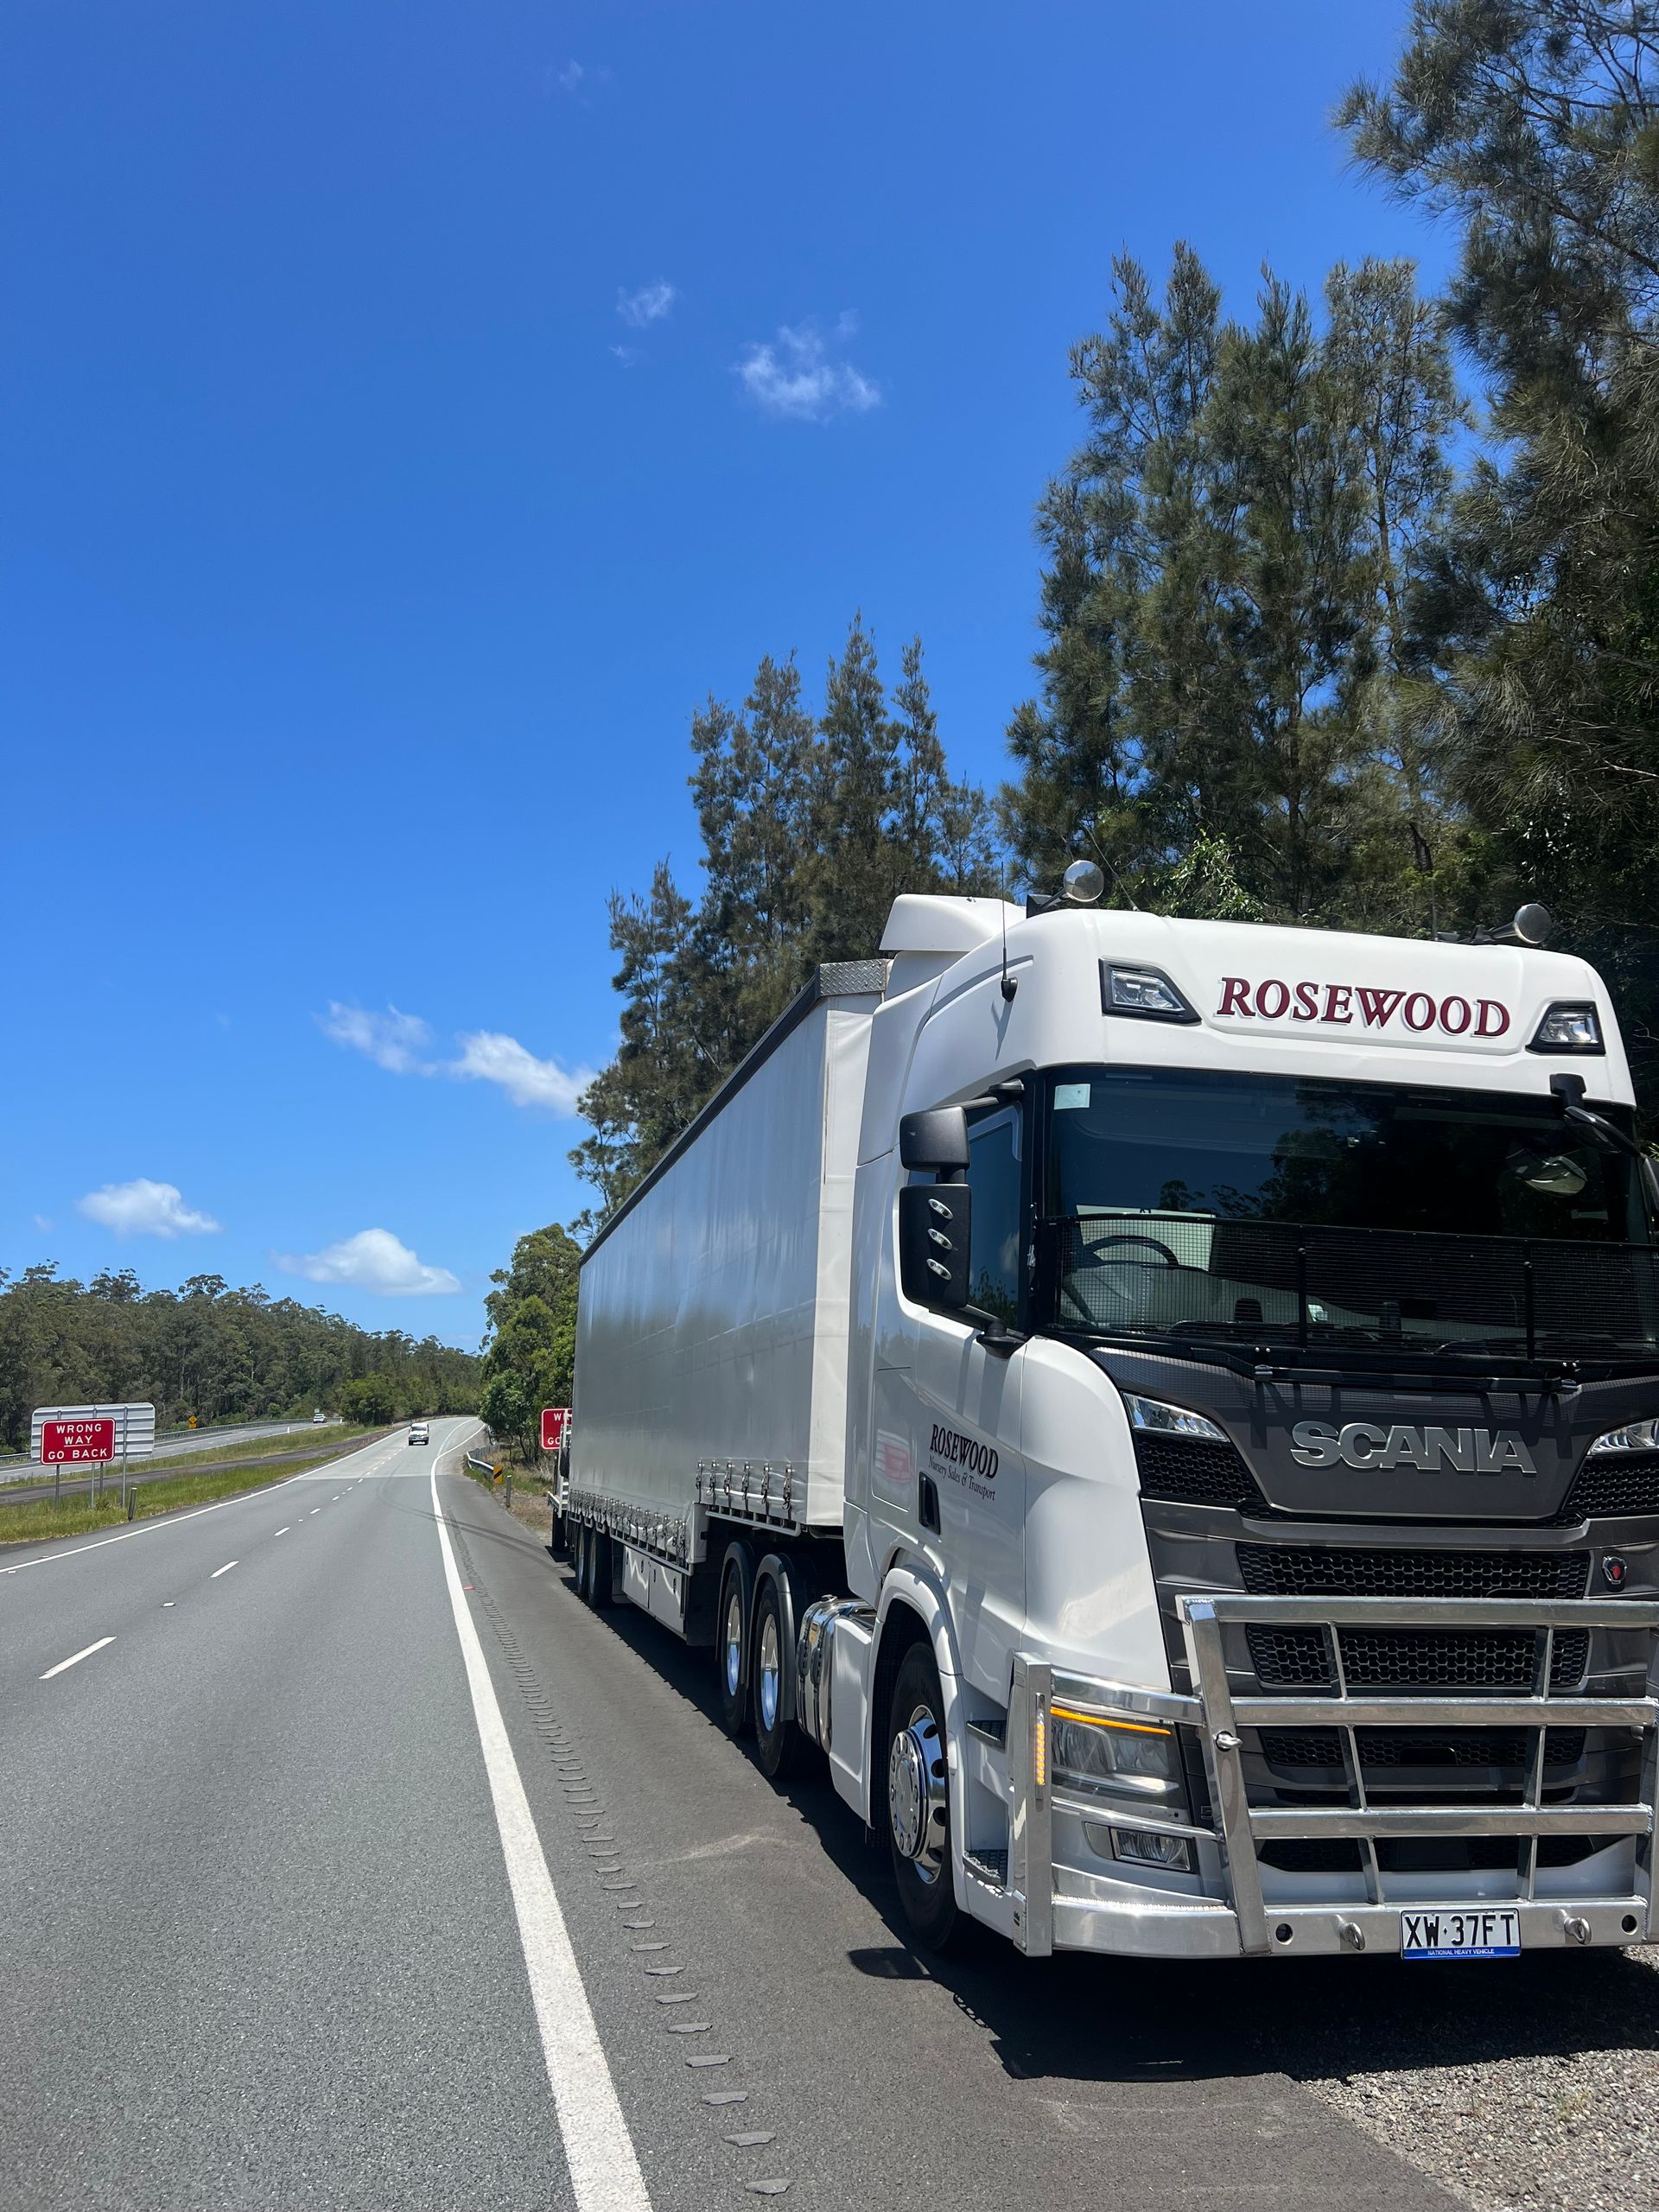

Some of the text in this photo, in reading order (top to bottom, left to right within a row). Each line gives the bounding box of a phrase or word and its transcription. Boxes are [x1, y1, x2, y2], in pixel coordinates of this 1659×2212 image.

[1215, 976, 1510, 1038] ROSEWOOD
[56, 1423, 102, 1433] WRONG
[64, 1435, 93, 1446] WAY
[930, 1423, 999, 1480] ROSEWOOD
[1290, 1420, 1537, 1475] SCANIA
[48, 1448, 107, 1460] GO BACK
[928, 1453, 996, 1501] Nursery Sales & Transport
